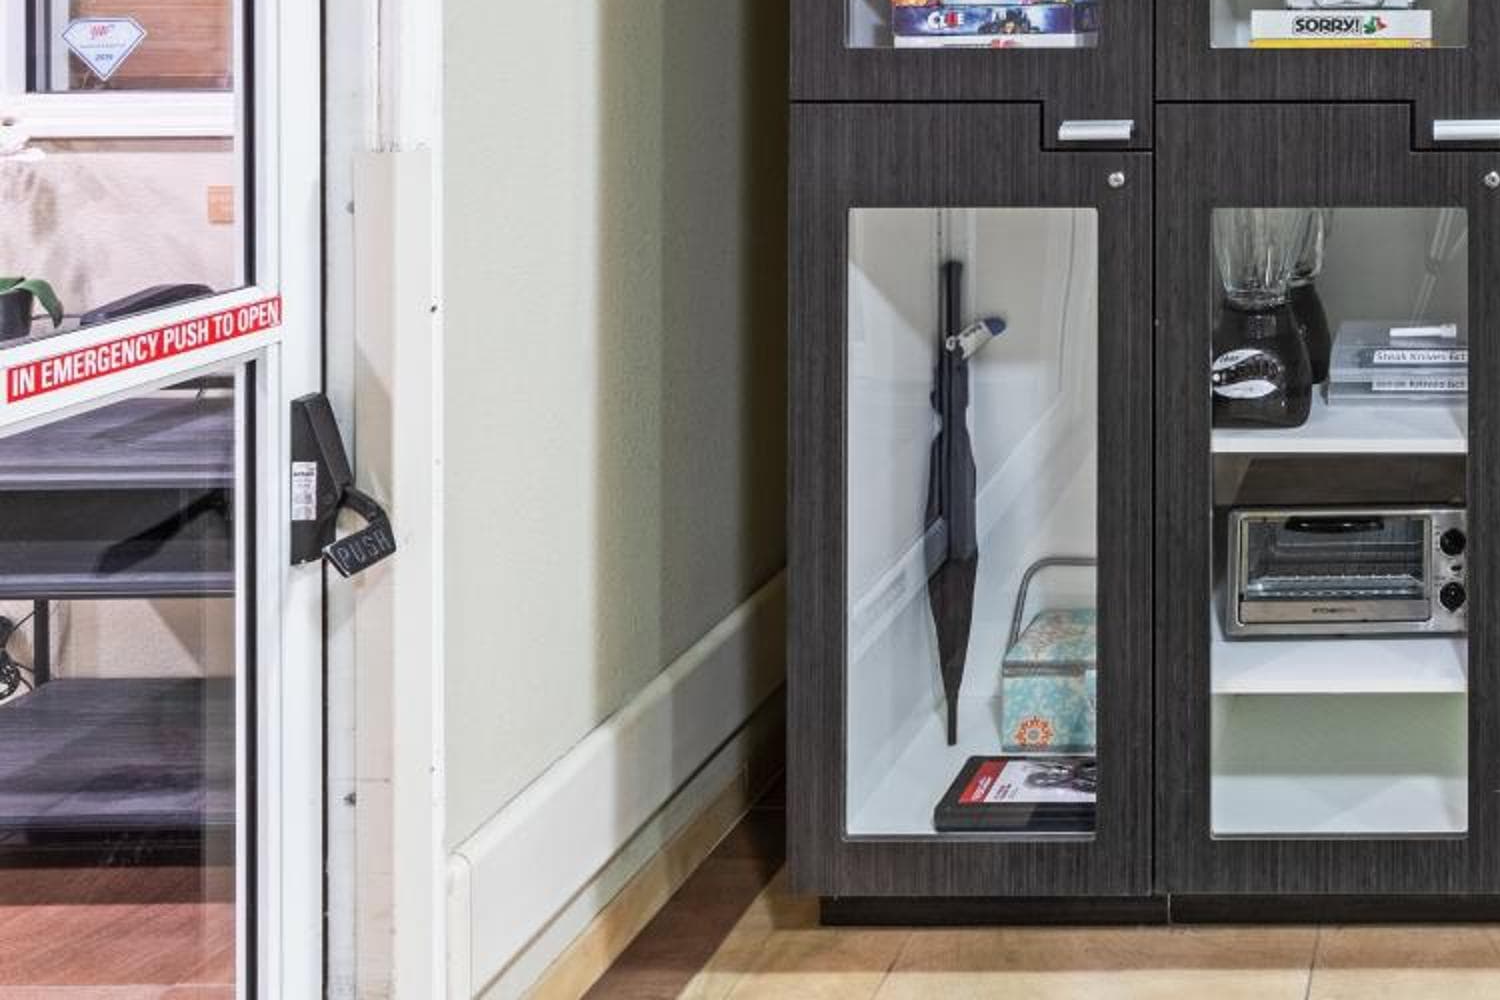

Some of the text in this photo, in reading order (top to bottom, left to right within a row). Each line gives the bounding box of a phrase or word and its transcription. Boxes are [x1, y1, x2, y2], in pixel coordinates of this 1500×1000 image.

[1295, 18, 1360, 32] SORRY!
[11, 299, 280, 396] IN EMERGENCY PUSH TO OPEN
[336, 529, 393, 570] PUSH
